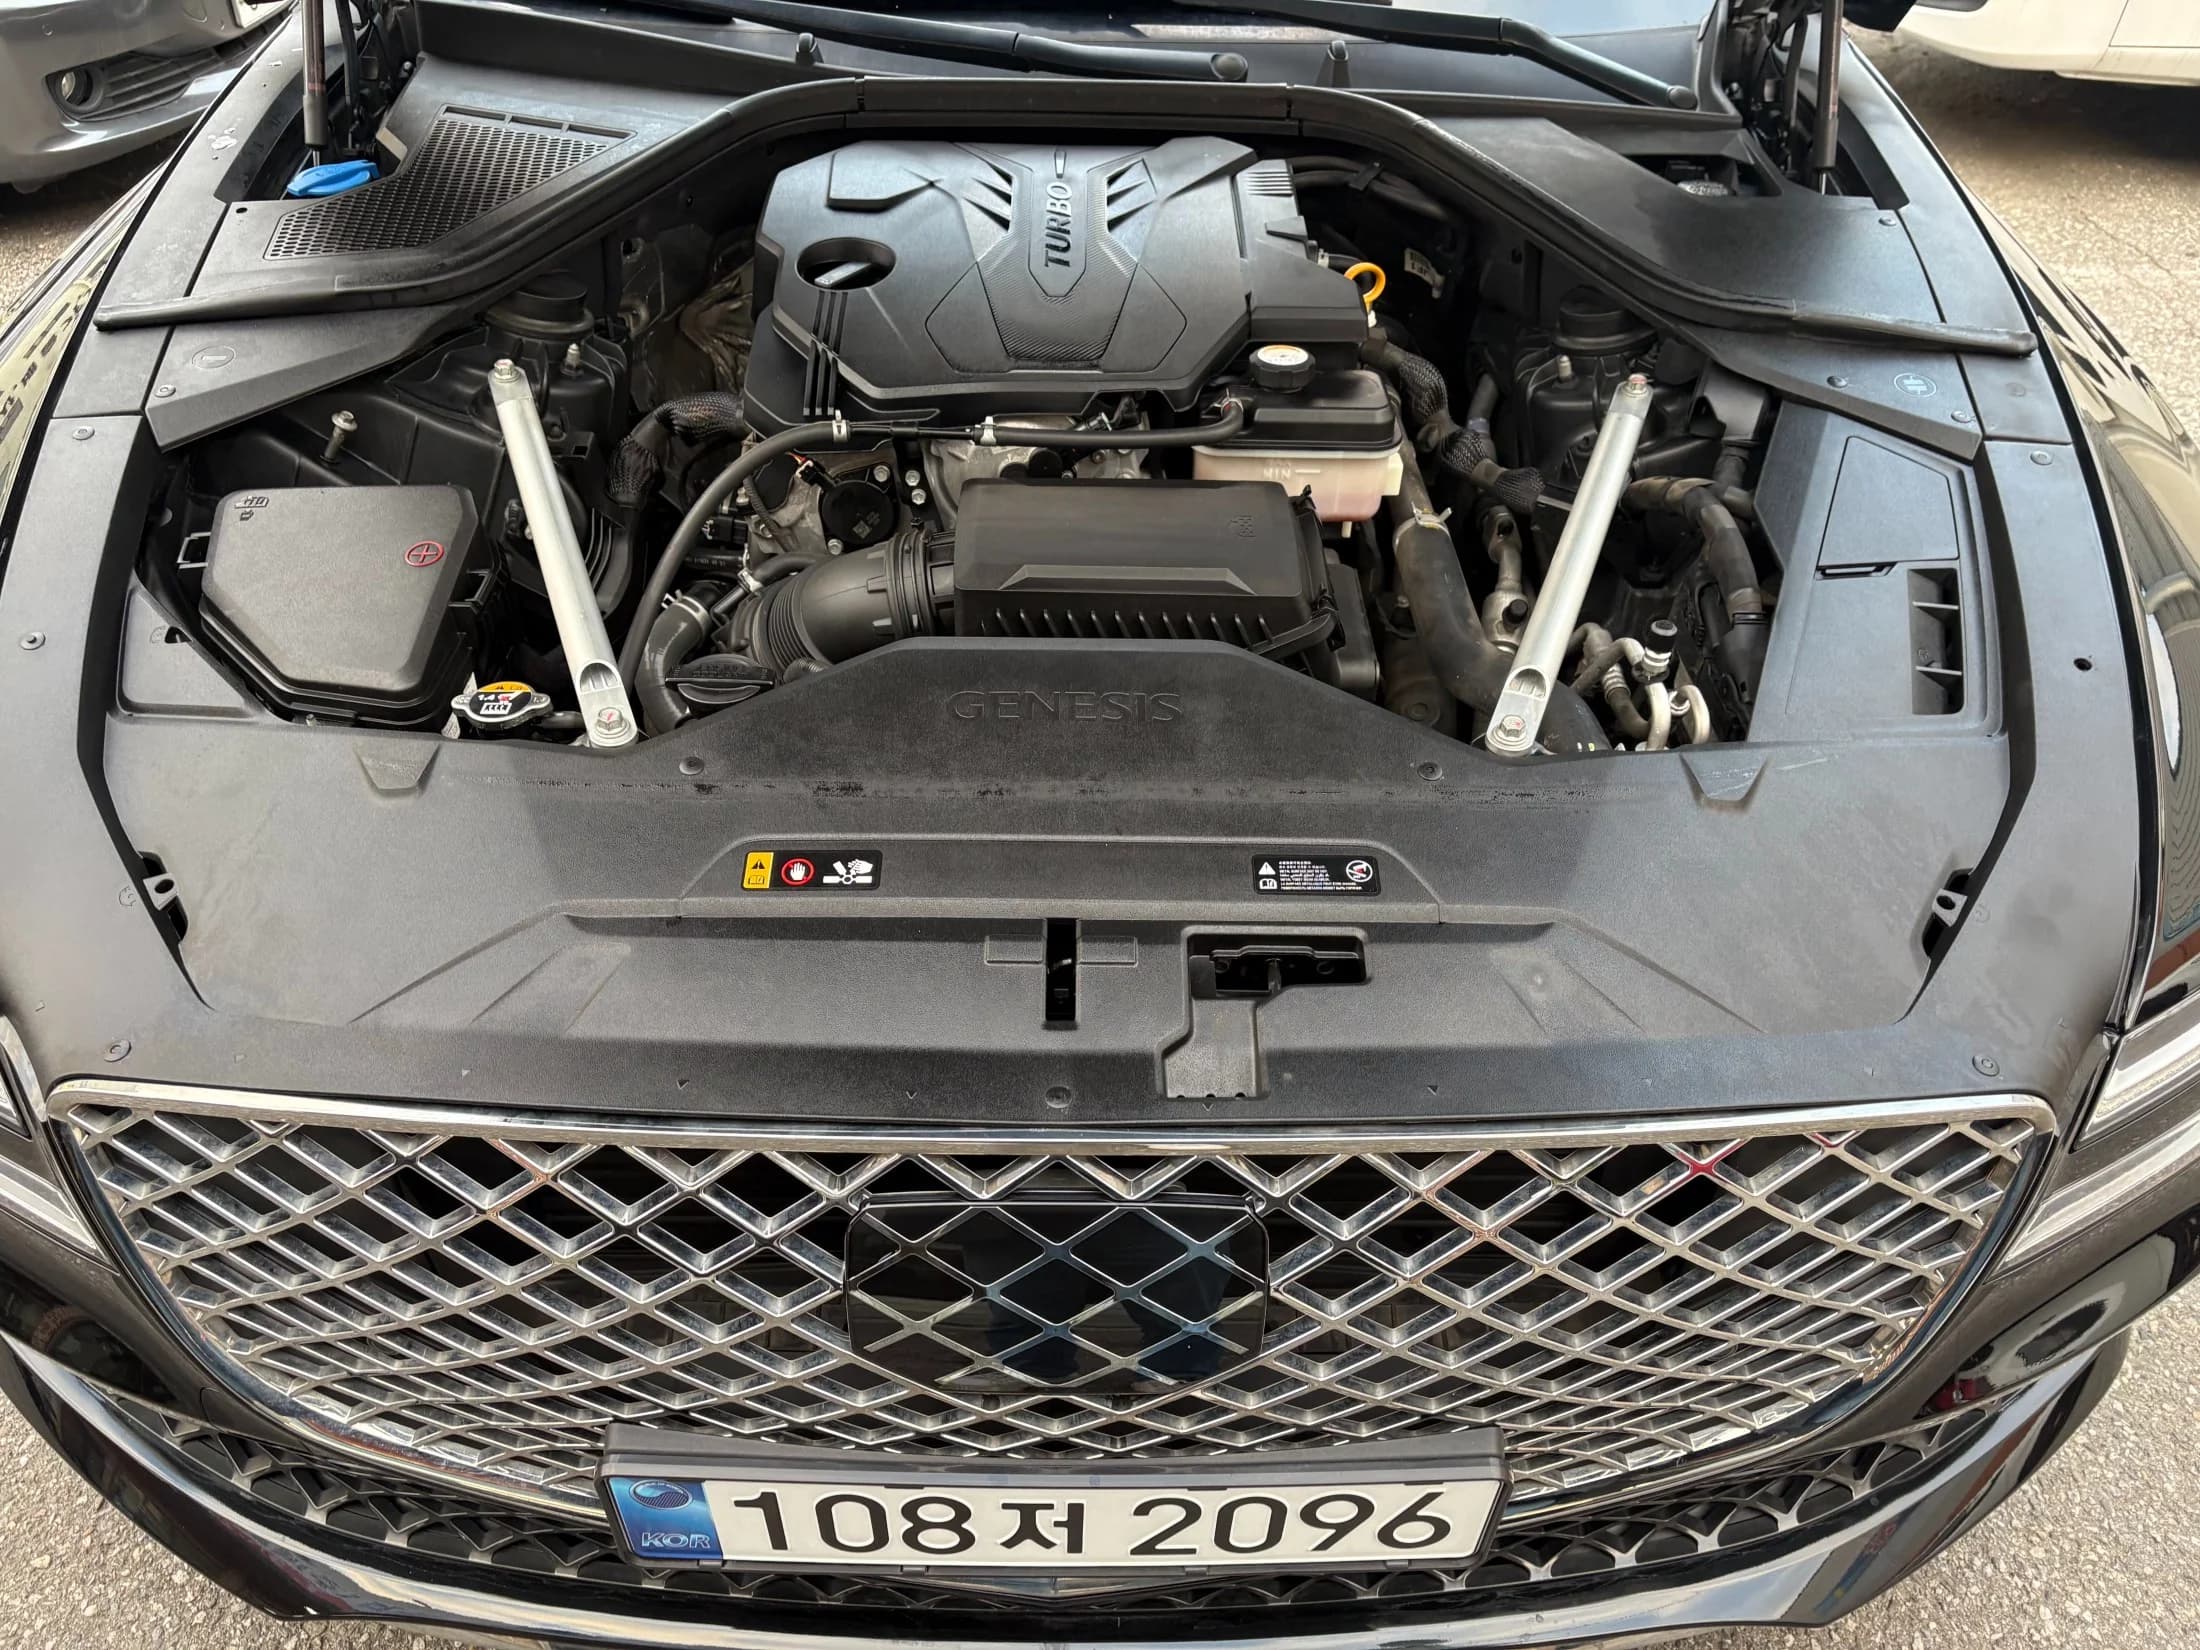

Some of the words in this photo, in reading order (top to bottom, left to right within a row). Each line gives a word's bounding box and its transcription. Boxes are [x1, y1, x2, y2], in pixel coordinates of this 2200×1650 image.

[1044, 182, 1072, 267] TURBO
[950, 691, 1182, 721] GENESIS
[641, 1532, 711, 1549] KOR
[1130, 1491, 1451, 1555] 2096
